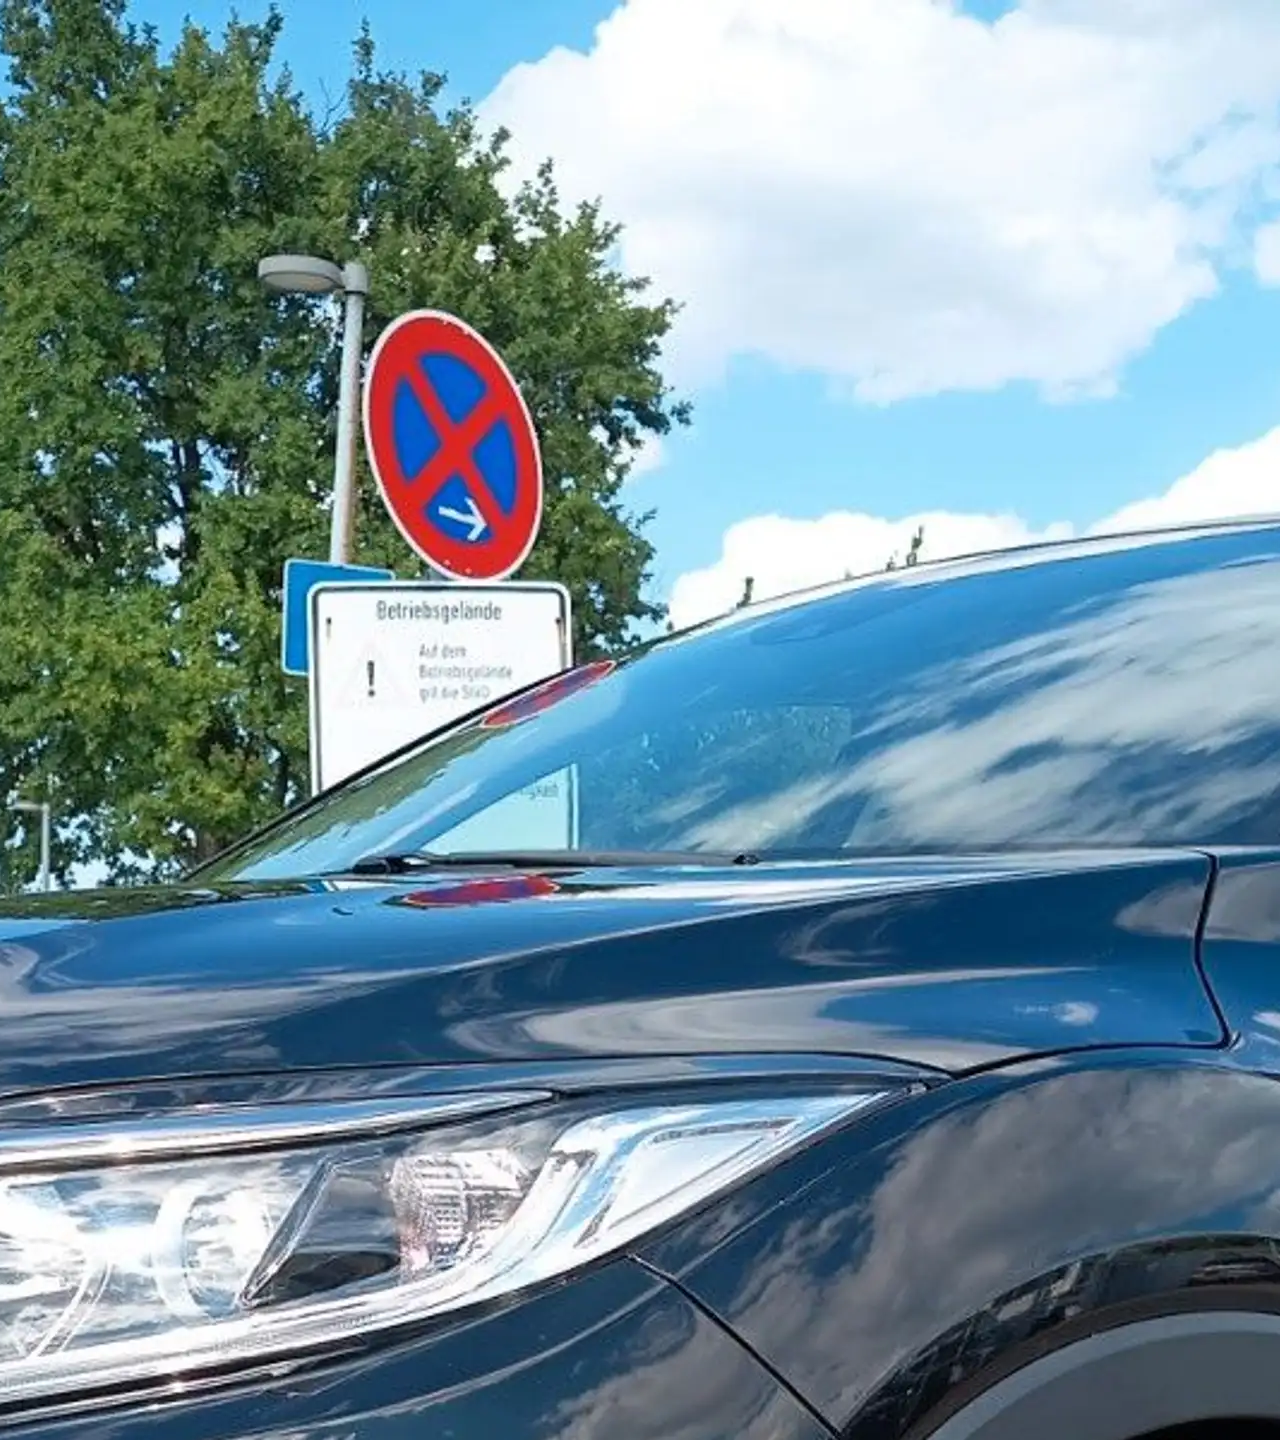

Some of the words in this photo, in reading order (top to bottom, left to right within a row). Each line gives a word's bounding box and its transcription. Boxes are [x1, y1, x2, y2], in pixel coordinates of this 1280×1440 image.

[376, 600, 502, 624] Betriebsgelände
[419, 643, 438, 658] Auf
[442, 643, 467, 659] dem
